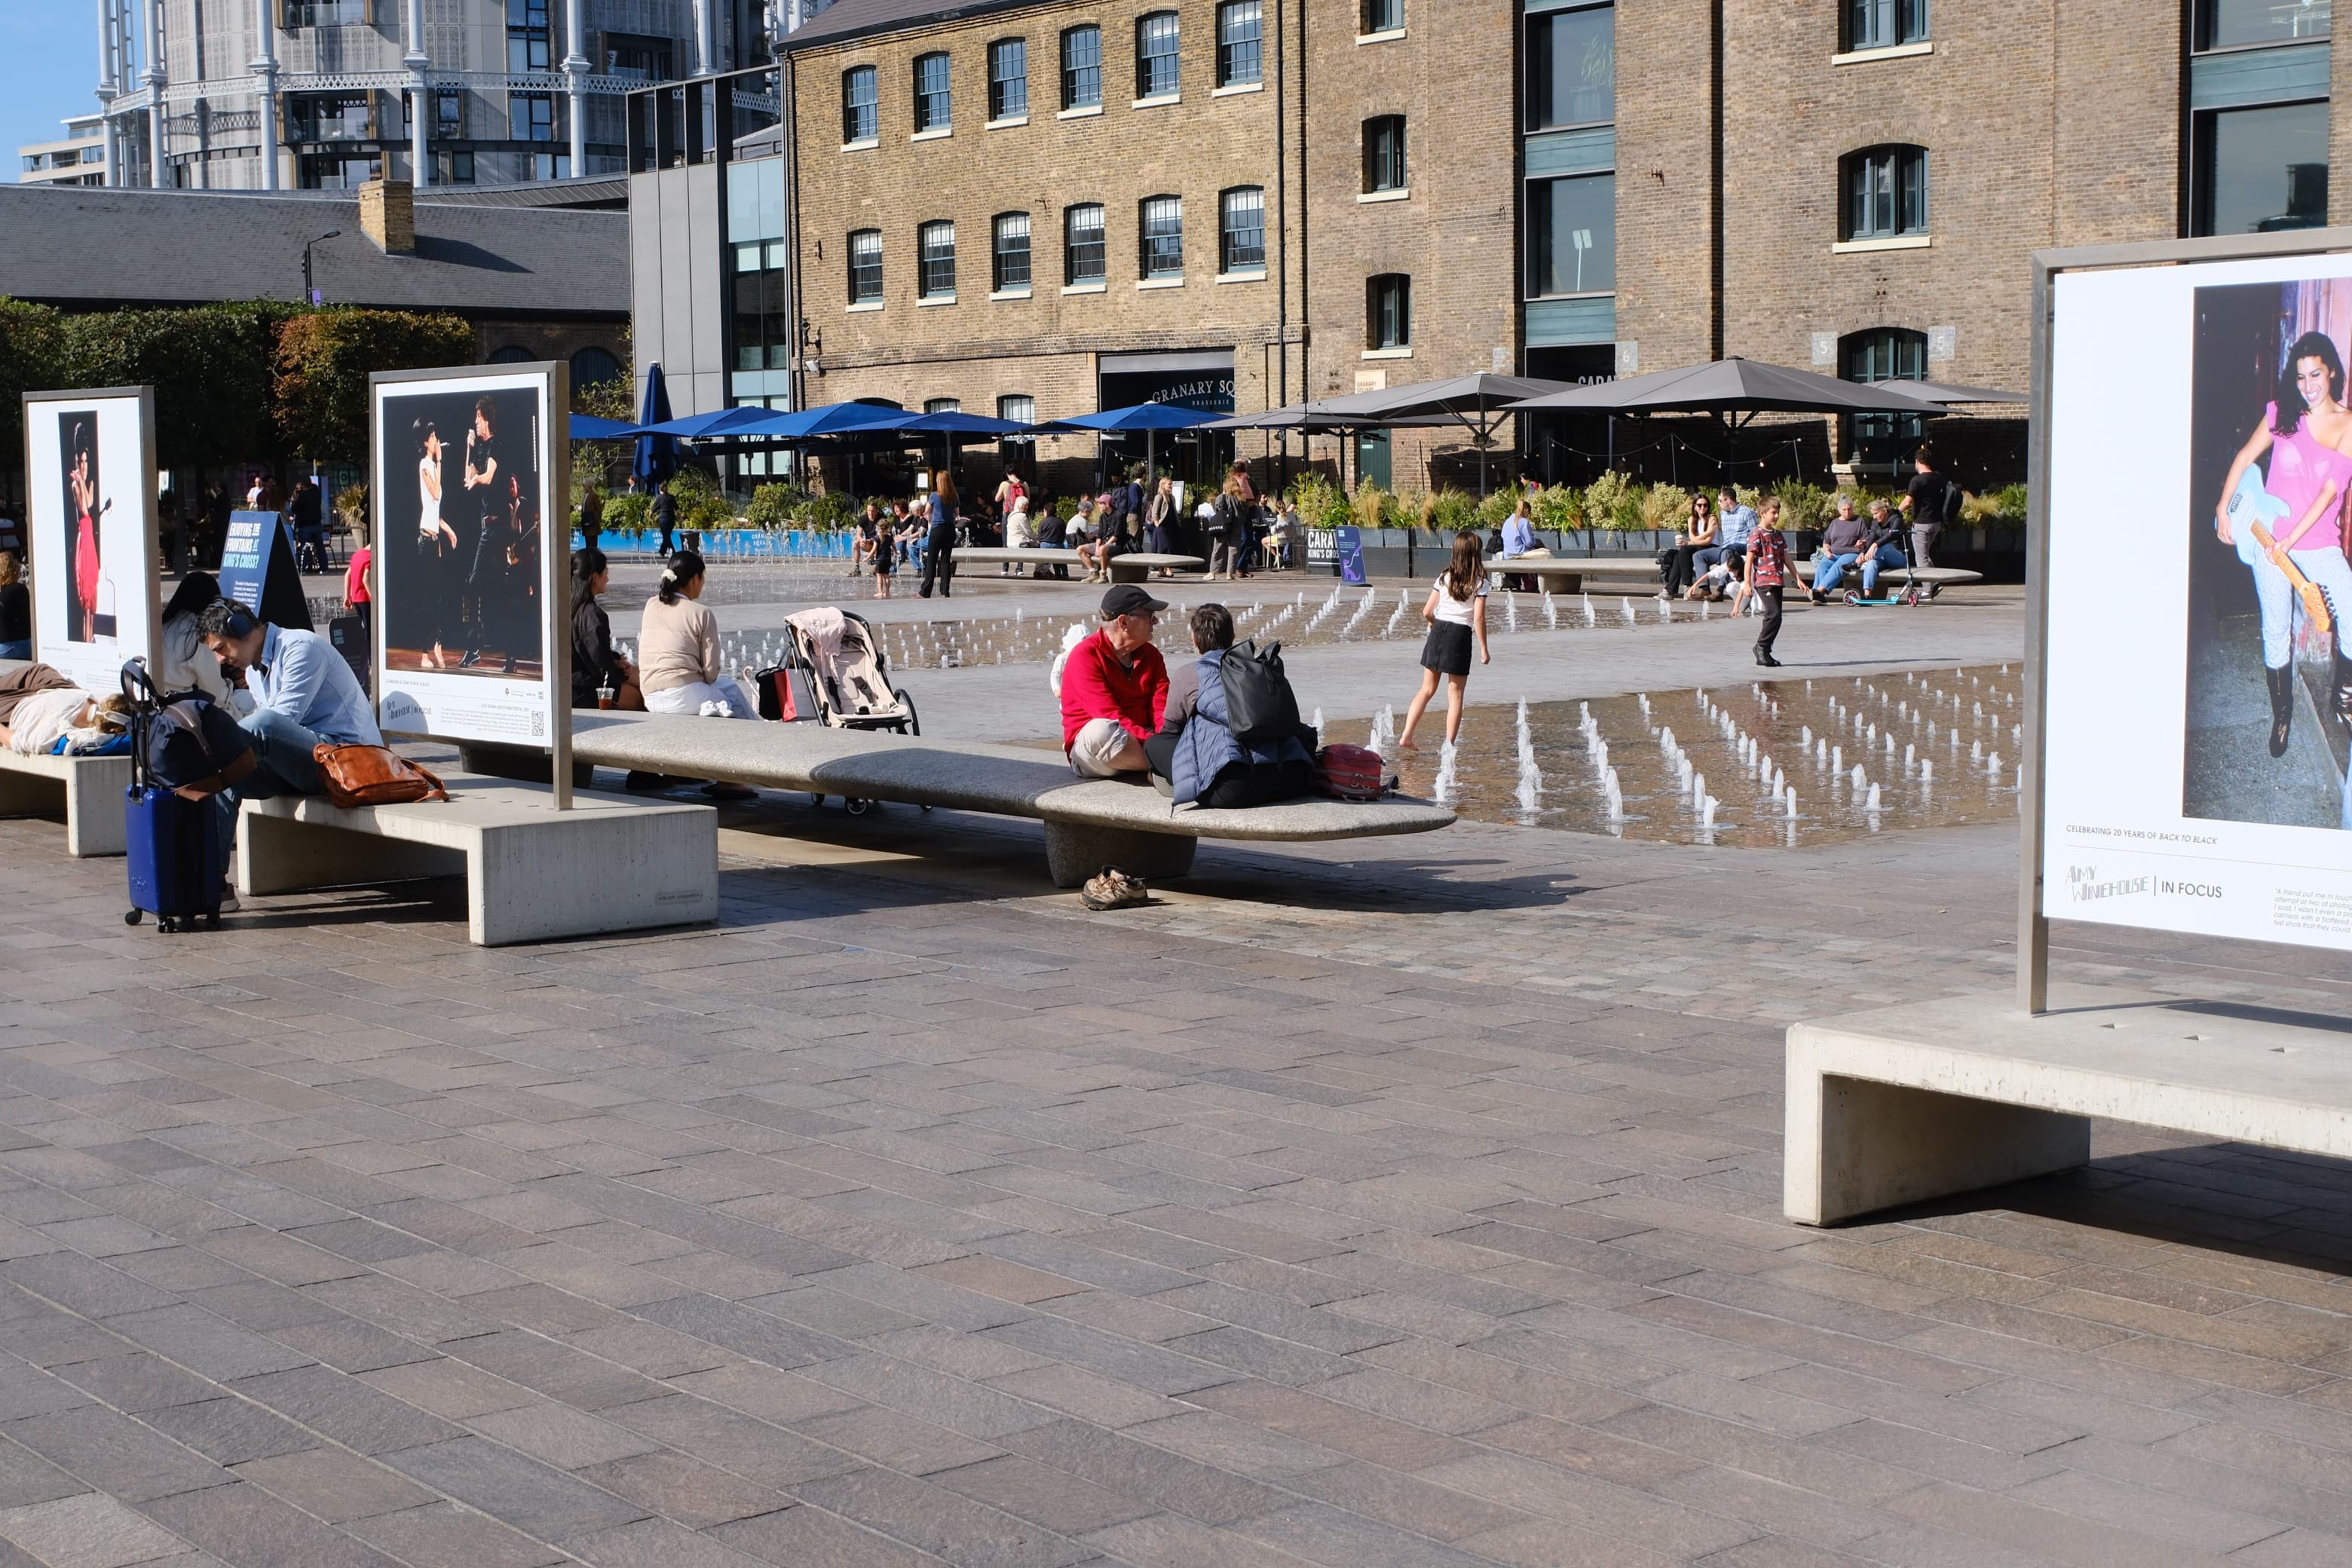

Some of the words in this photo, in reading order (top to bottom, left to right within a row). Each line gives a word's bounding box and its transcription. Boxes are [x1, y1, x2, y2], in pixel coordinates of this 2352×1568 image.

[1821, 341, 1828, 354] 5
[1622, 350, 1630, 363] 6
[1152, 381, 1214, 403] GRANARY
[229, 522, 253, 537] ENJOYING
[226, 537, 254, 553] FOUNTAINS
[223, 553, 240, 567] KING'S
[239, 554, 259, 569] CROSS?
[1308, 548, 1327, 559] KING'S
[2066, 825, 2112, 835] CELEBRATING
[2124, 829, 2145, 838] YEARS
[2159, 833, 2180, 842] BACK
[2182, 835, 2191, 843] TO
[2193, 836, 2218, 845] BLACK
[2065, 865, 2097, 885] AMY
[2072, 876, 2148, 903] WINEHOUSE
[2161, 880, 2174, 893] IN
[2178, 882, 2222, 899] FOCUS
